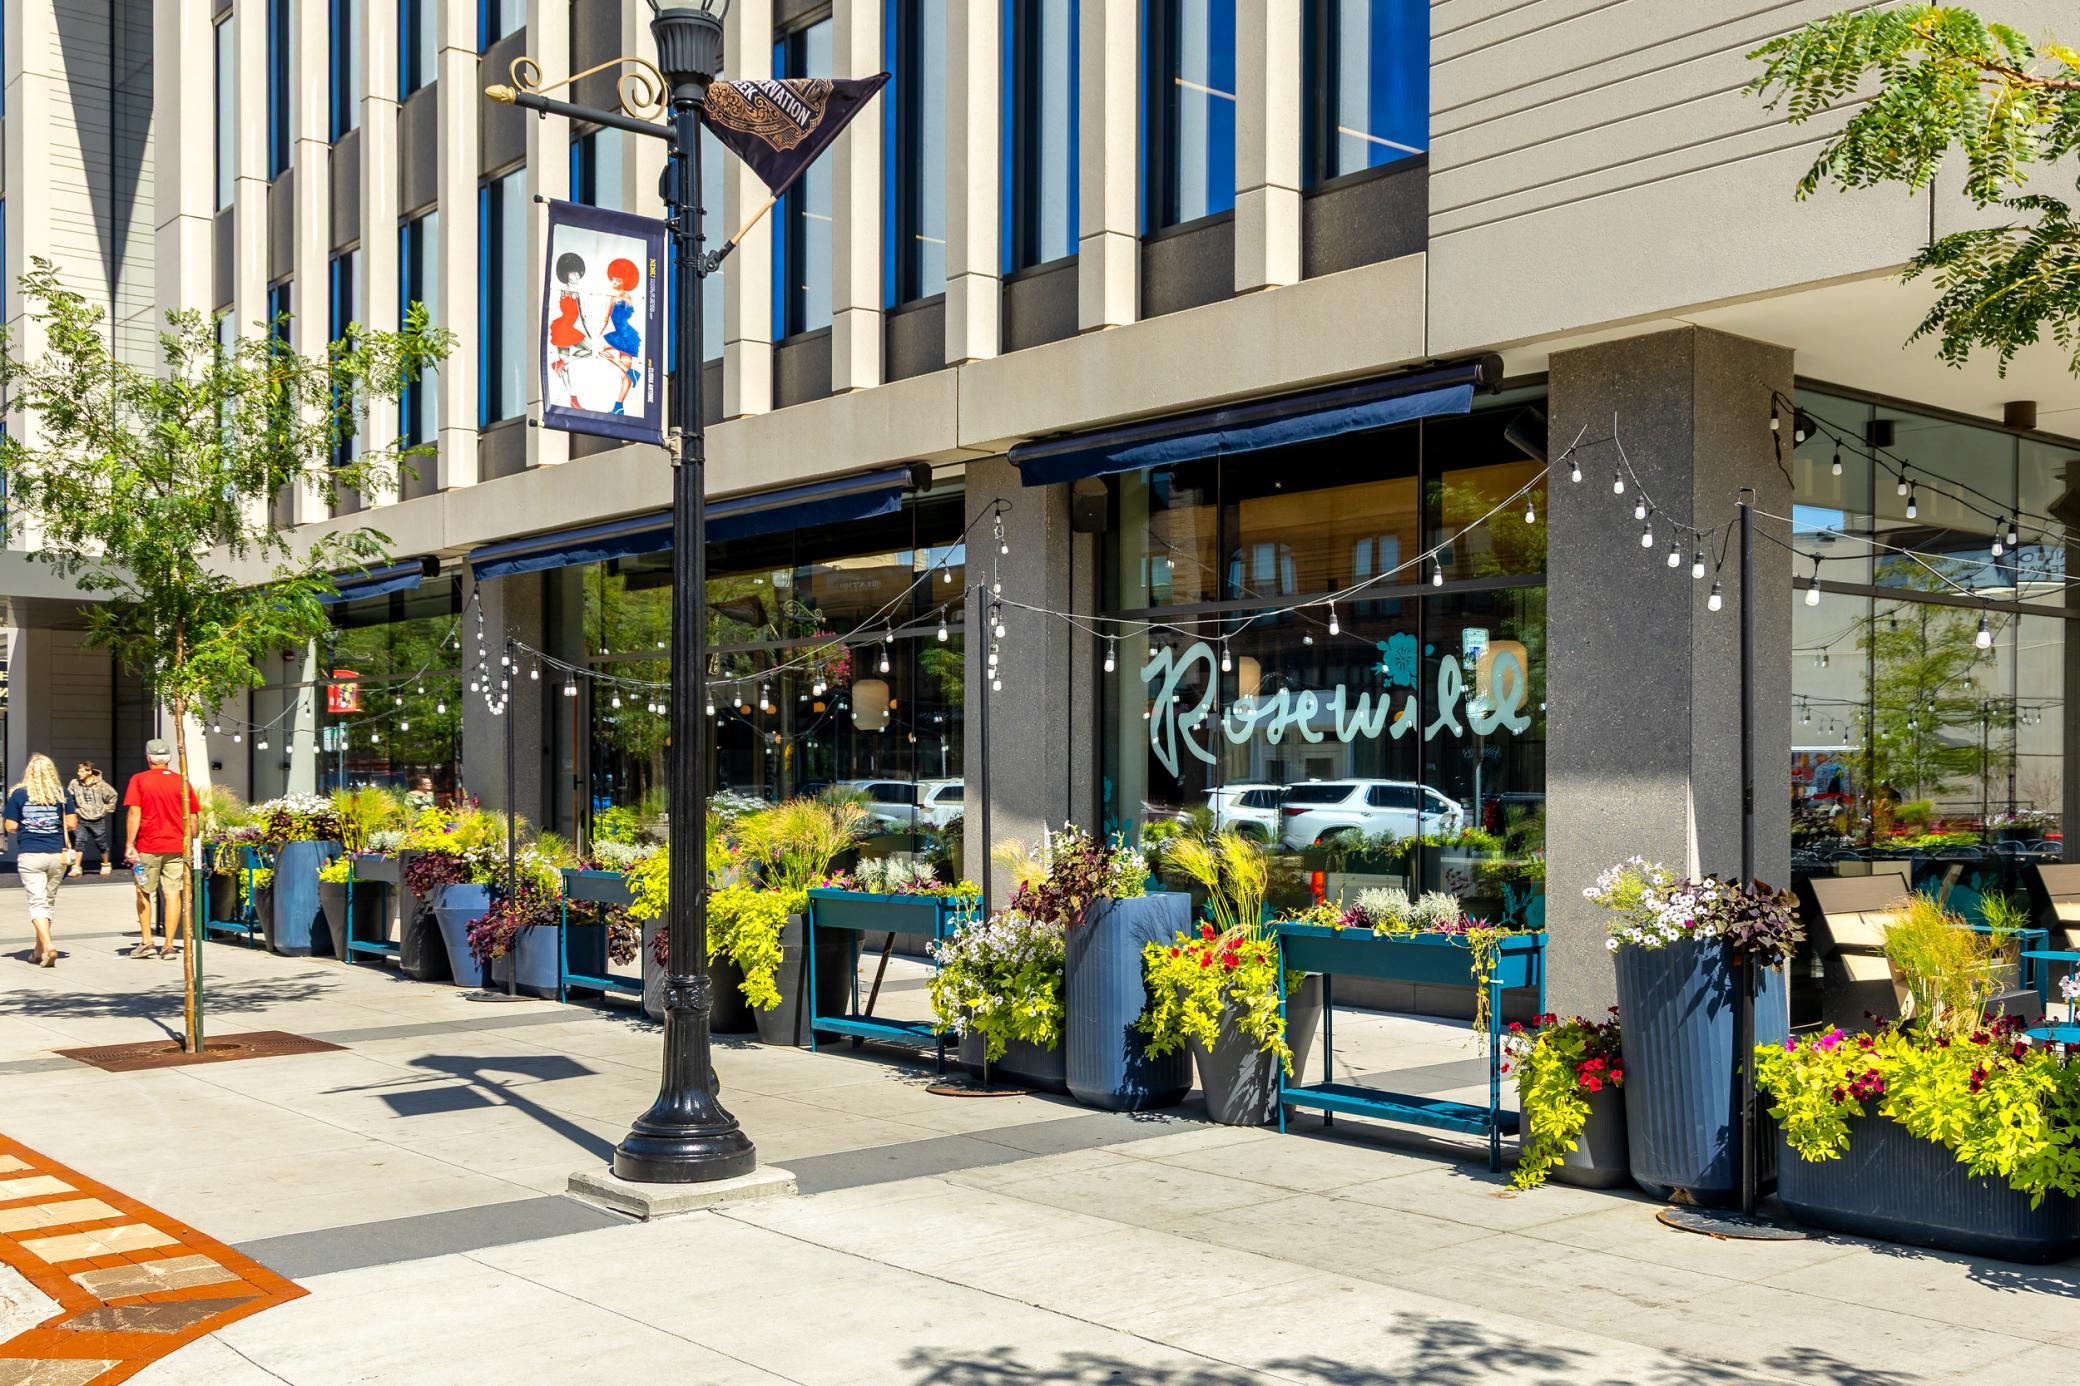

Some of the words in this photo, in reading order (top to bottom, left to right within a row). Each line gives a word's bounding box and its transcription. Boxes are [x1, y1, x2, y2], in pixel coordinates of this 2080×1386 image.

[731, 80, 758, 101] EEK
[754, 80, 810, 127] ERVATION
[1141, 641, 1531, 778] Rosewild
